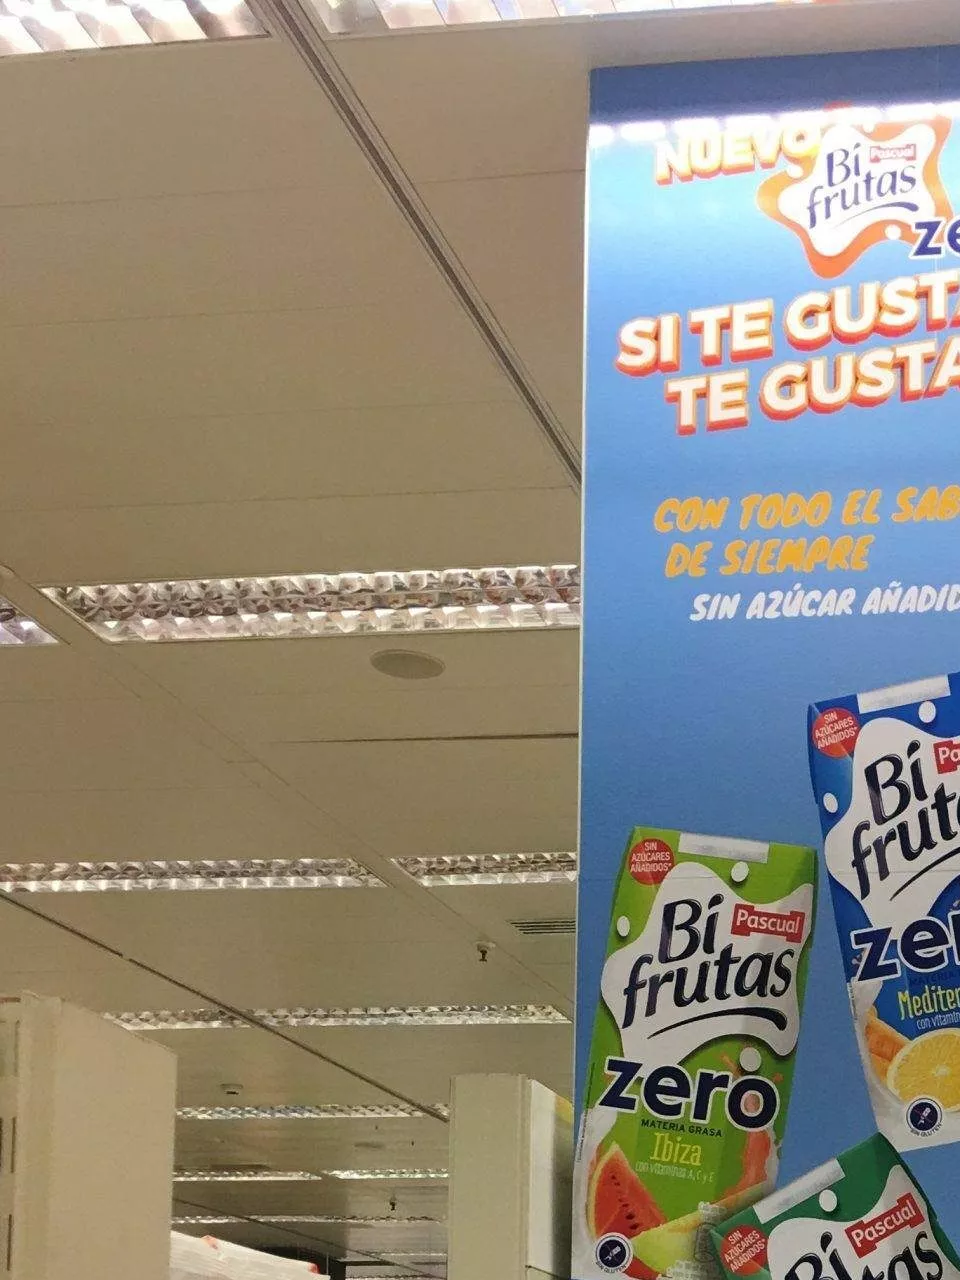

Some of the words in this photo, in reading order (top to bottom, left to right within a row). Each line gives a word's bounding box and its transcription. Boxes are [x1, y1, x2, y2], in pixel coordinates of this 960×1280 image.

[807, 164, 917, 228] frutas
[615, 313, 681, 375] SI
[689, 298, 773, 367] TE
[664, 368, 749, 435] TE
[655, 497, 728, 534] CON
[740, 490, 832, 531] TODO
[843, 489, 883, 526] EL
[665, 543, 708, 578] DE
[721, 534, 874, 576] SIEMPRE
[690, 593, 740, 622] SIN
[747, 583, 854, 619] AZÚCAR
[823, 710, 838, 723] SIN
[632, 851, 670, 862] AZÚCARES
[644, 841, 657, 850] SIN
[737, 909, 800, 933] Pascual
[622, 943, 794, 1029] frutas
[917, 1017, 931, 1030] con
[599, 1057, 778, 1129] zero
[641, 1119, 685, 1132] MATERIA
[689, 1125, 722, 1137] GRASA
[650, 1133, 701, 1166] Ibiza
[728, 1231, 742, 1246] SIN
[851, 1202, 916, 1247] Pascual
